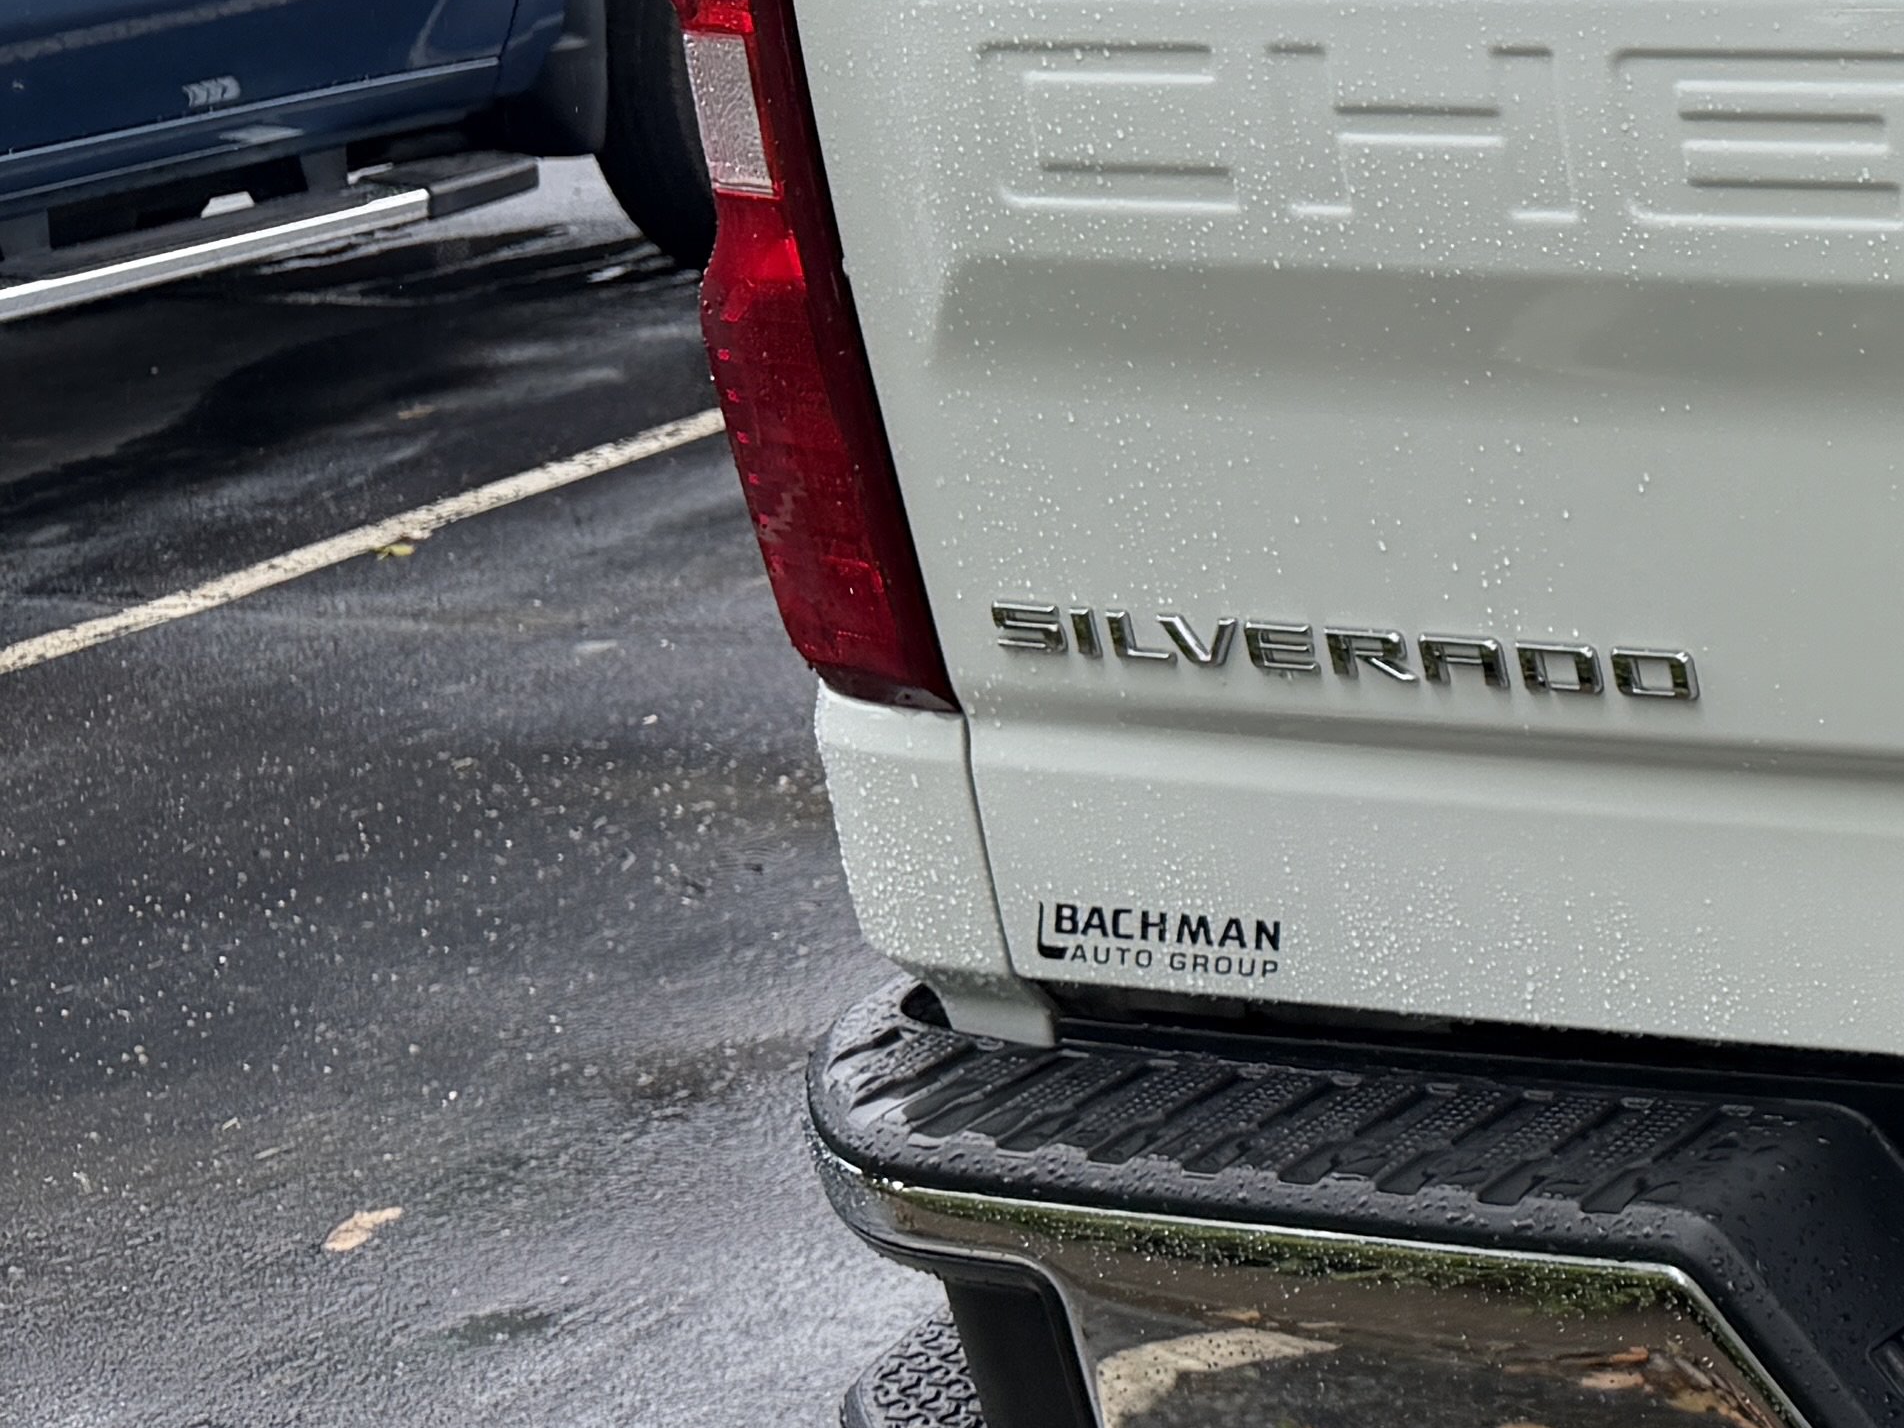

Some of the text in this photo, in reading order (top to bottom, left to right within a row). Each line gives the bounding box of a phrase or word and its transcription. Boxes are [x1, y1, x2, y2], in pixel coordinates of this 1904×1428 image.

[990, 600, 1701, 701] SILVERADO
[1054, 903, 1281, 951] BACHMAN
[1070, 944, 1279, 978] AUTO GROUP
